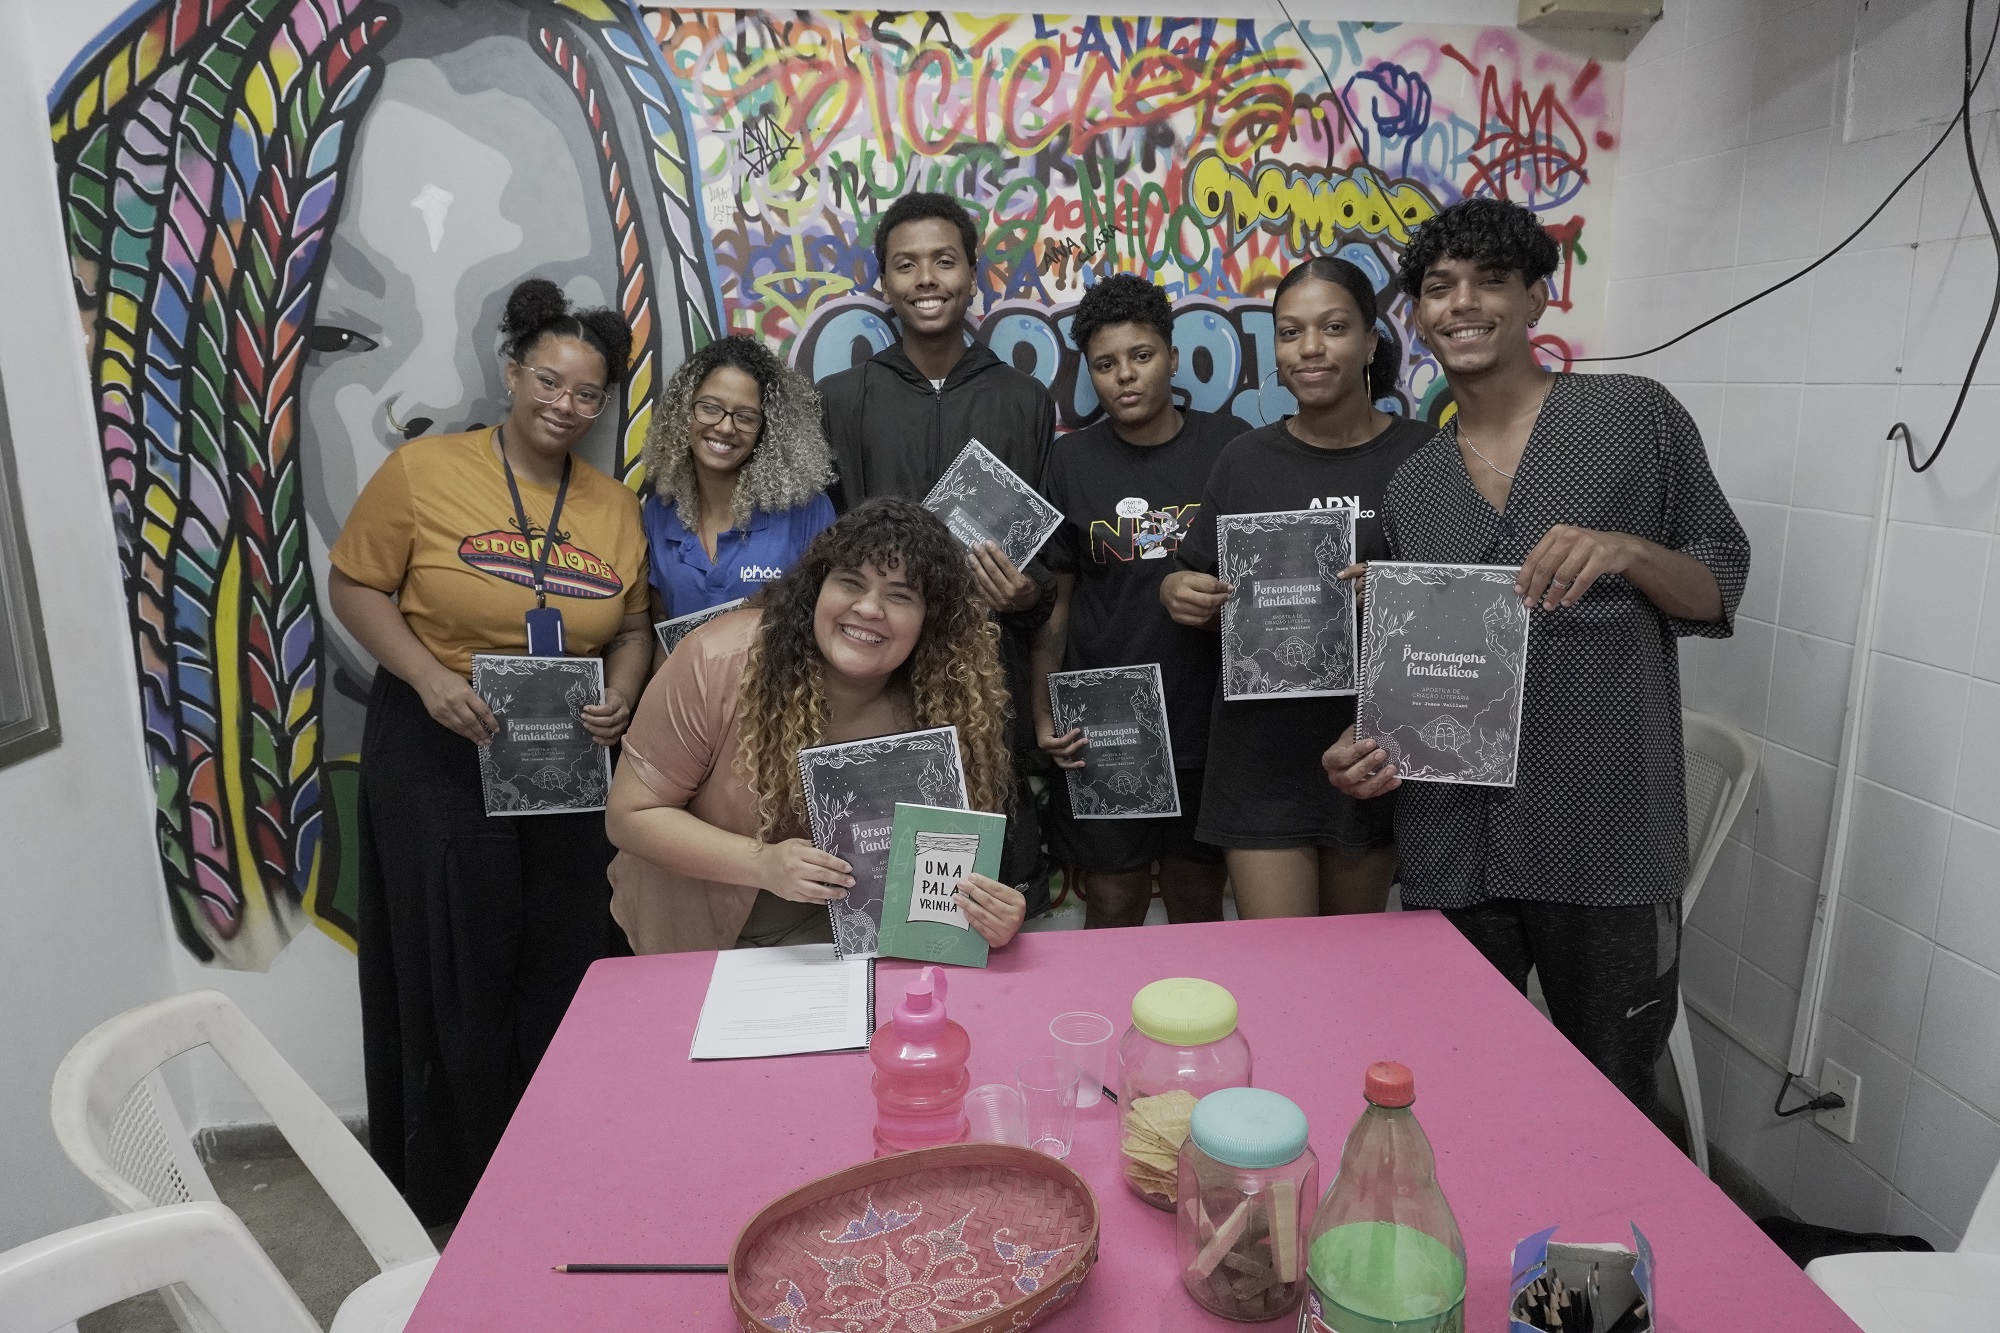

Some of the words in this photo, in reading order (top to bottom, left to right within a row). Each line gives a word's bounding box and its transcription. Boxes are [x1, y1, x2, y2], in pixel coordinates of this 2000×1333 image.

[1043, 236, 1081, 269] ANA
[1077, 224, 1123, 264] CLARA
[948, 506, 987, 545] Personag
[1253, 582, 1321, 597] Personagens
[1258, 594, 1316, 609] fantásticos
[1402, 644, 1487, 668] Personagens
[1406, 662, 1480, 679] fantásticos
[507, 719, 573, 733] Personagens
[1083, 726, 1140, 739] Personagens
[512, 731, 570, 742] fantásticos
[1089, 736, 1137, 748] fantásticos
[925, 860, 962, 878] UMA
[922, 879, 960, 897] PALA
[919, 897, 958, 913] VRINHA
